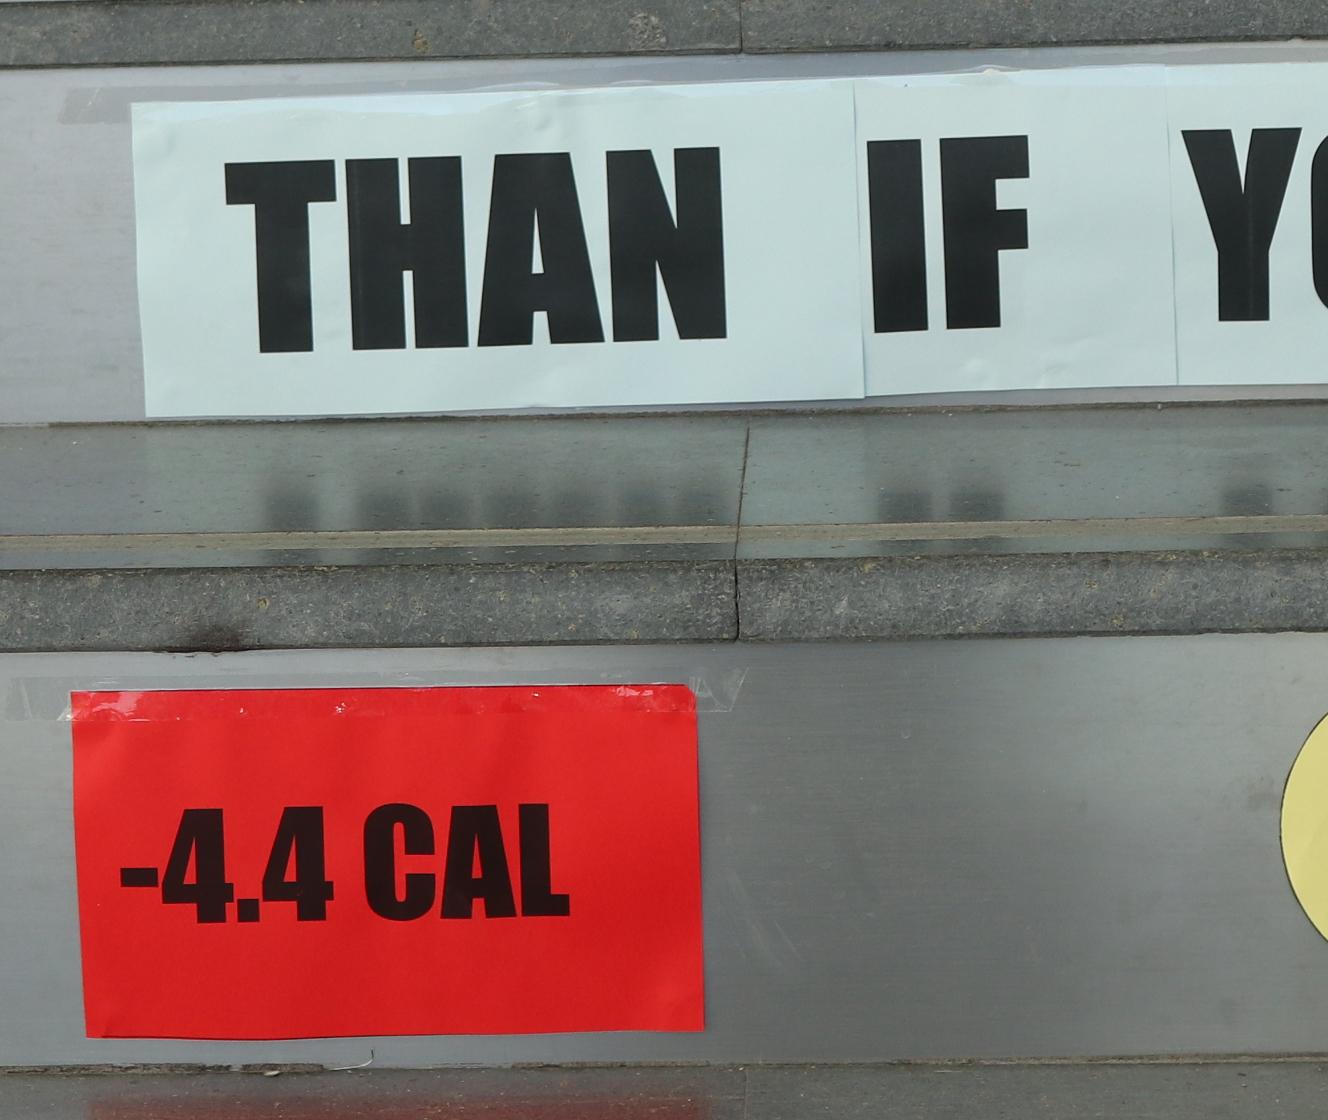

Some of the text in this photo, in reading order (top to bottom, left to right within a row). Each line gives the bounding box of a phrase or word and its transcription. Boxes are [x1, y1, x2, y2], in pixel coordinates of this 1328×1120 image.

[224, 146, 727, 354] THAN
[866, 134, 1031, 334] IF
[119, 802, 570, 924] -4.4 CAL
